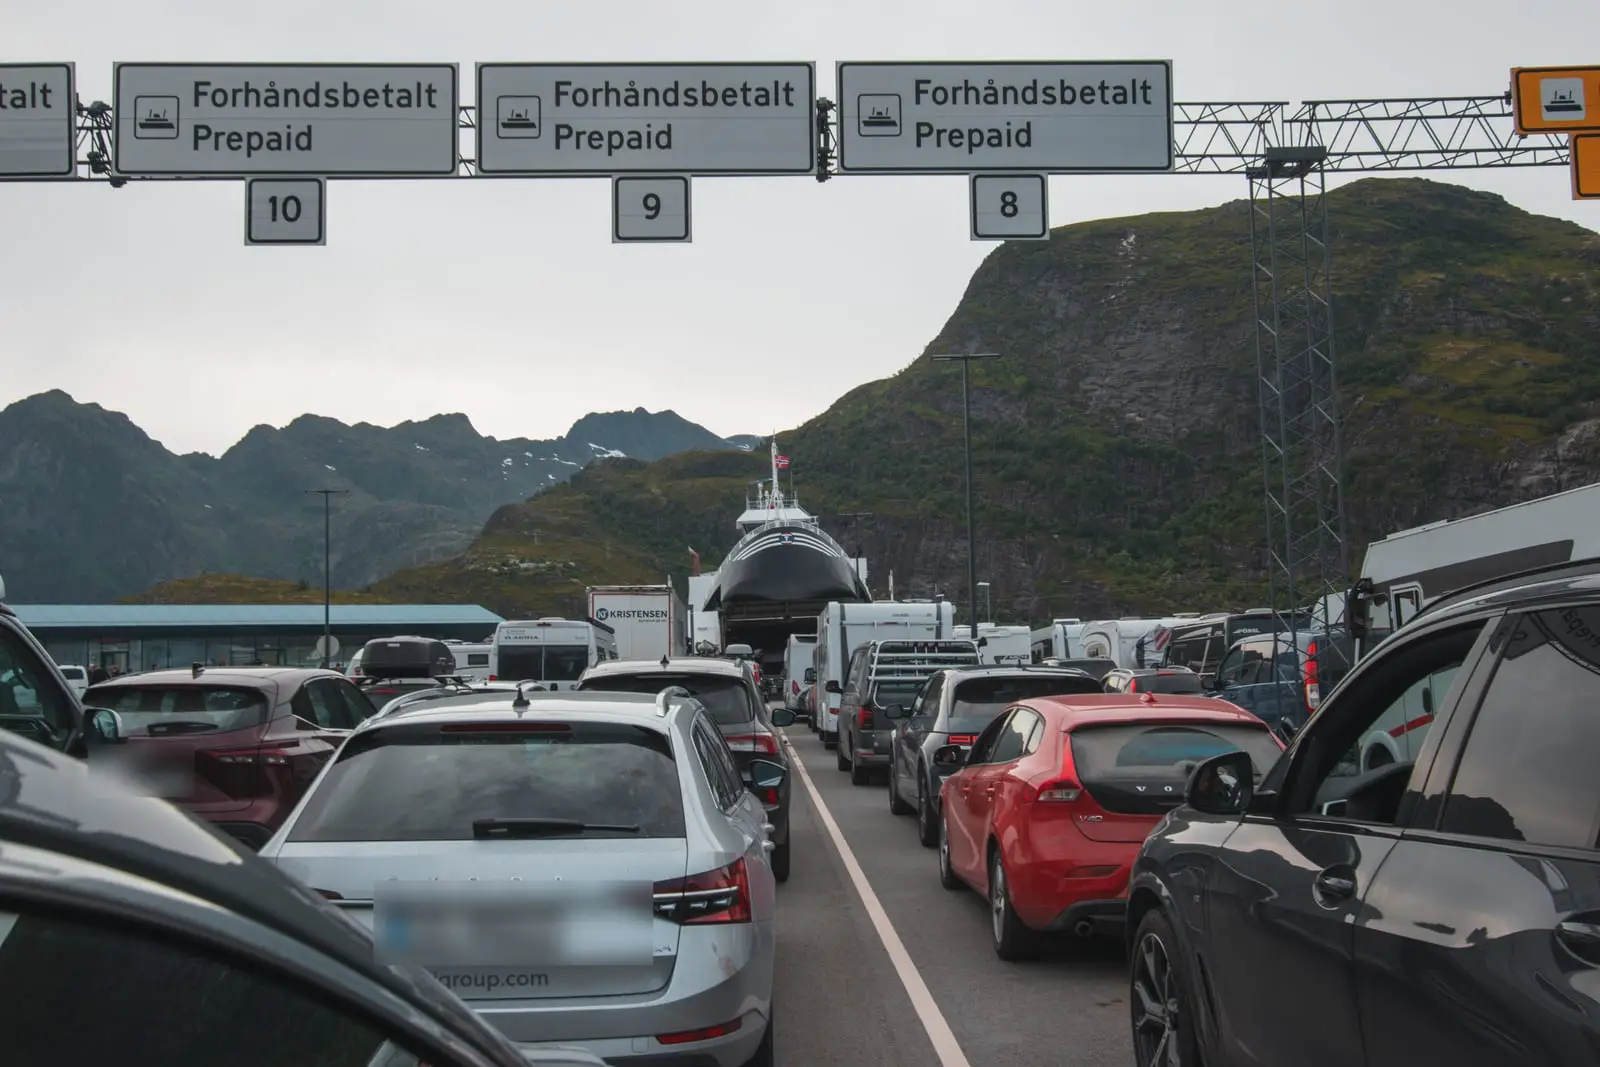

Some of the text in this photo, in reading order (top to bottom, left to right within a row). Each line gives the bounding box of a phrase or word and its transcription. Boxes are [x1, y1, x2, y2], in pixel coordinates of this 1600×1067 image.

[194, 80, 437, 108] Forhåndsbetalt
[555, 80, 795, 107] Forhåndsbetalt
[915, 78, 1152, 105] Forhåndsbetalt
[194, 124, 312, 157] Prepaid
[555, 123, 672, 156] Prepaid
[916, 121, 1032, 154] Prepaid
[268, 195, 302, 223] 10
[642, 193, 661, 220] 9
[1000, 190, 1019, 218] 8
[610, 610, 668, 619] KRISTENSEN
[1079, 815, 1104, 823] V40
